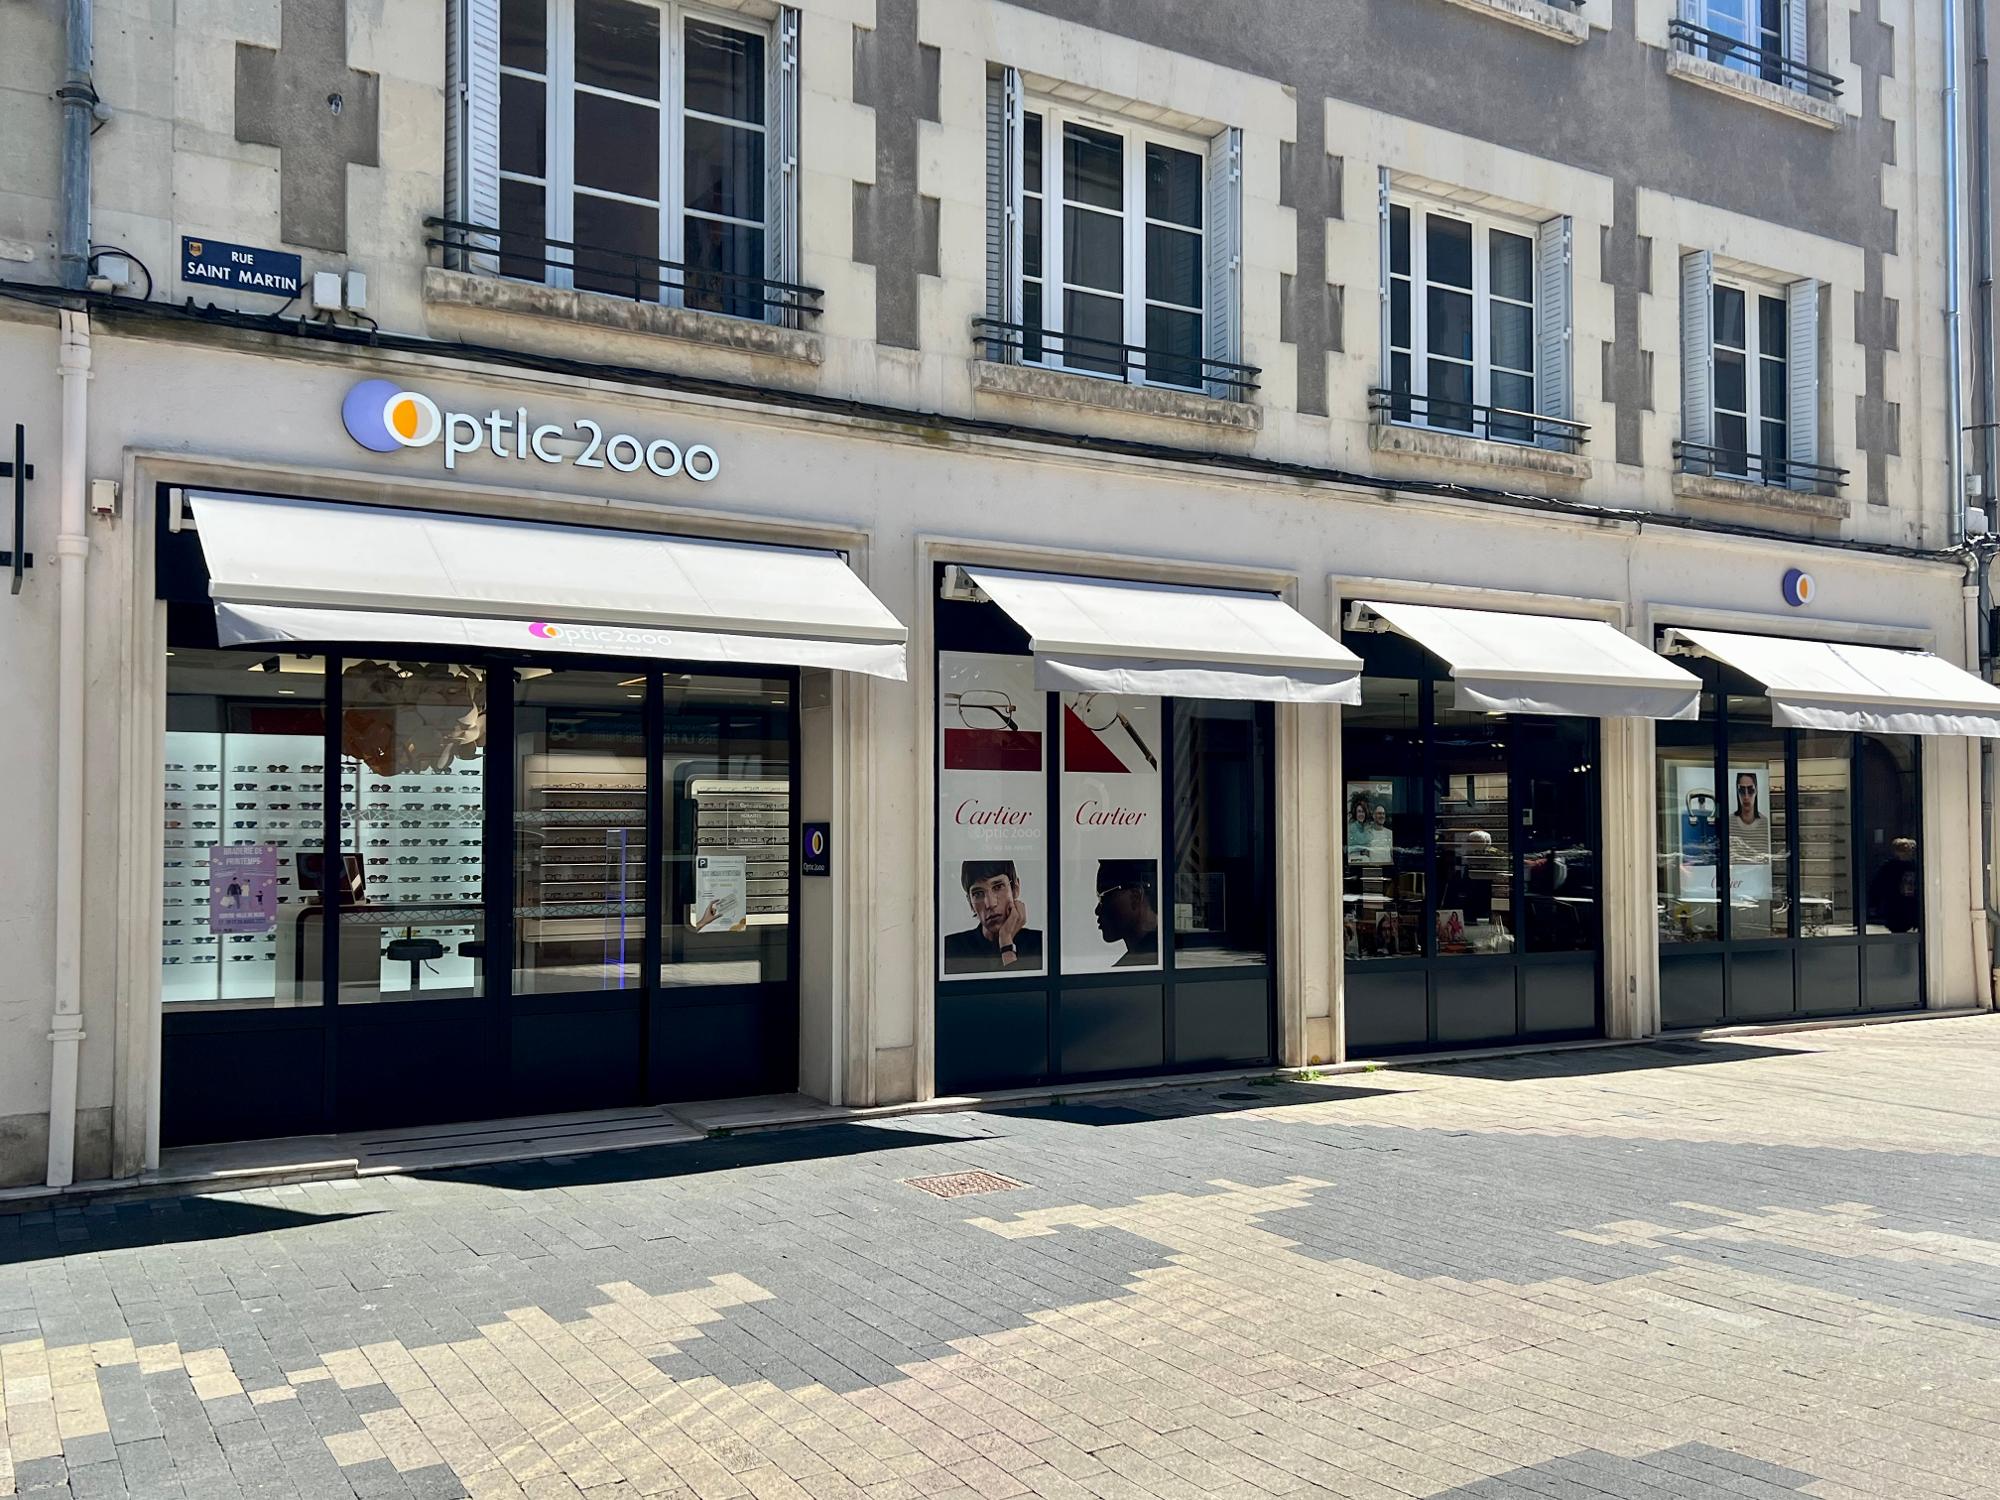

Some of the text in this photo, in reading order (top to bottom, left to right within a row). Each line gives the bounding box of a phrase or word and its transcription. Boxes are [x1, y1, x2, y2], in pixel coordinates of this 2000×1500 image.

[231, 251, 254, 265] RUE
[187, 261, 297, 291] SAINT MARTIN
[382, 391, 721, 482] Optic 2000
[955, 799, 1033, 825] Cartier
[1075, 800, 1147, 826] Cartier
